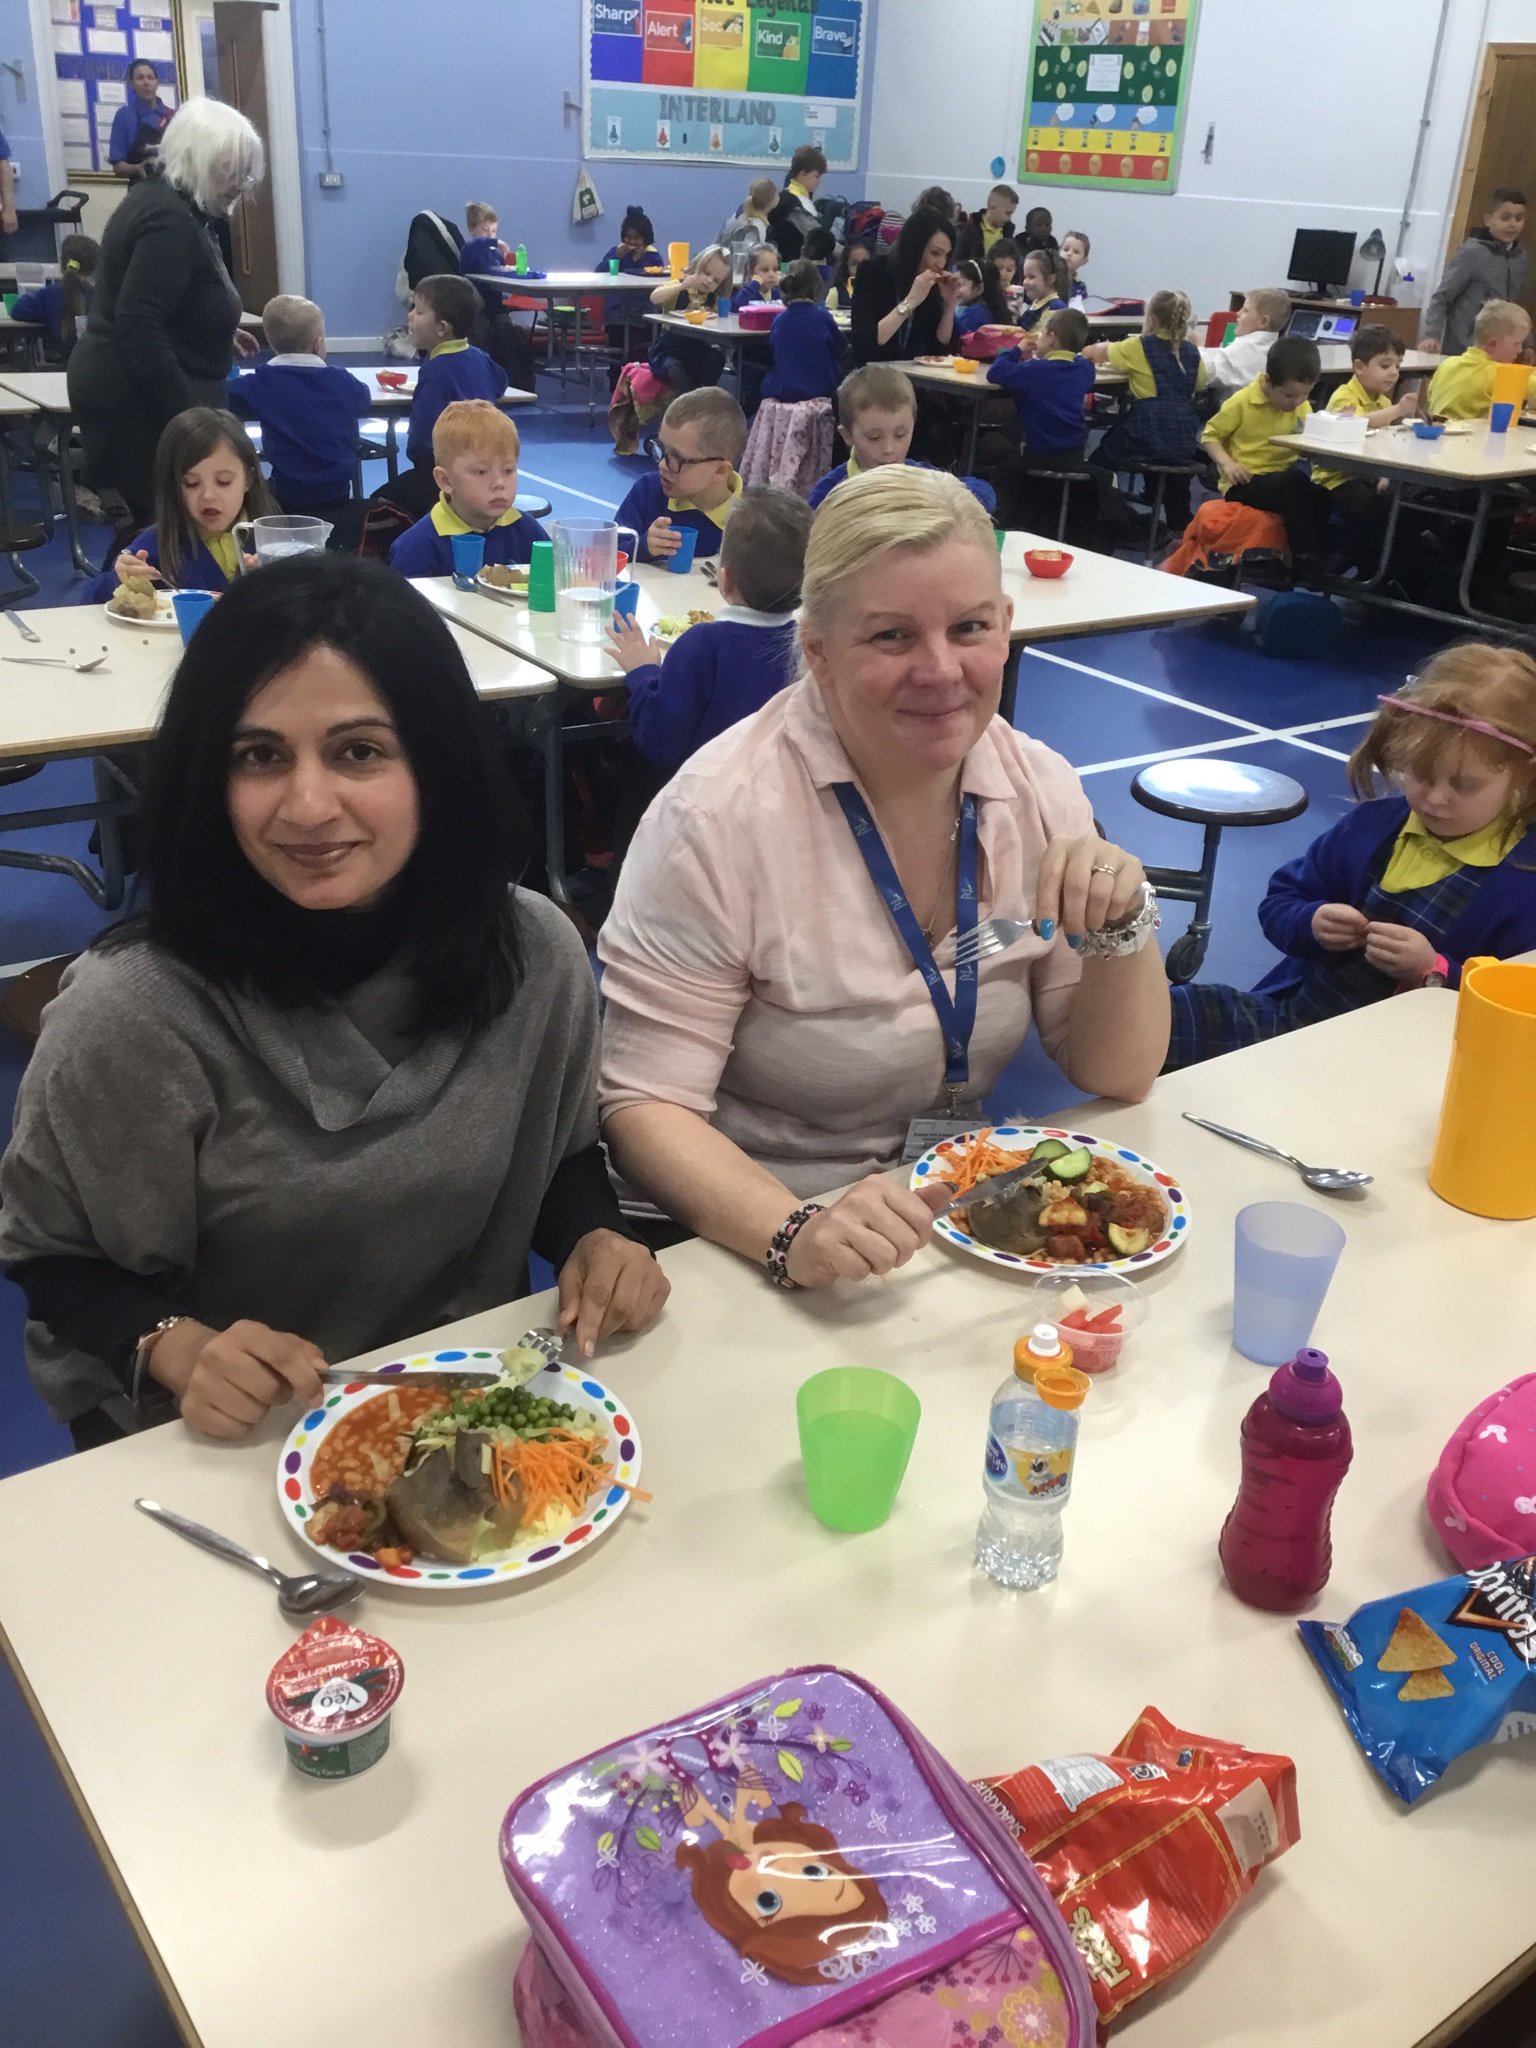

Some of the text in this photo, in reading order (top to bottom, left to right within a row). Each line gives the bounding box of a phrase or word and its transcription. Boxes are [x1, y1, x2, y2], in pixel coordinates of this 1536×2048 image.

[595, 3, 634, 25] Sharp
[701, 16, 742, 34] Secre
[647, 20, 679, 38] Alert
[758, 28, 783, 45] Kind
[814, 25, 848, 42] Brave
[659, 94, 777, 126] INTERLAND
[1470, 1641, 1497, 1681] ORIGINAL
[1487, 1651, 1505, 1675] COOL
[972, 1780, 1026, 1839] SNACKRITE
